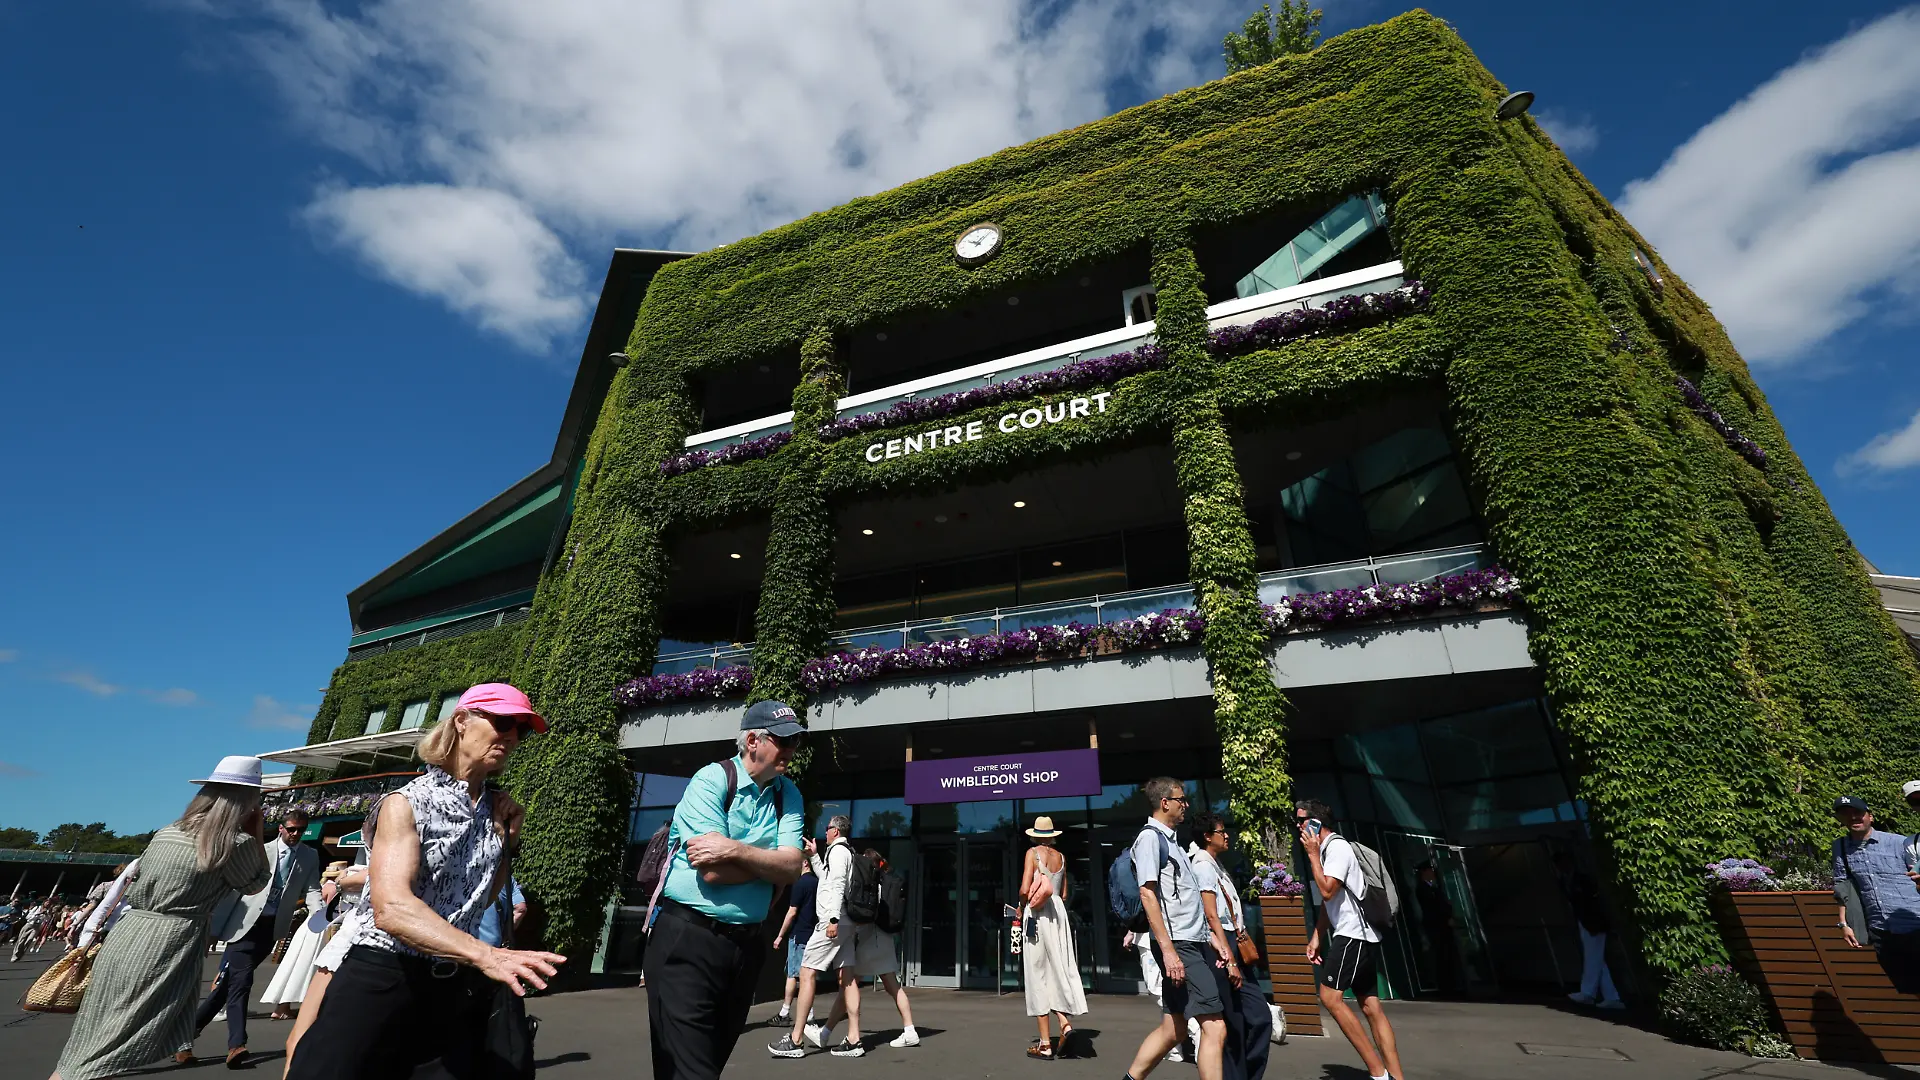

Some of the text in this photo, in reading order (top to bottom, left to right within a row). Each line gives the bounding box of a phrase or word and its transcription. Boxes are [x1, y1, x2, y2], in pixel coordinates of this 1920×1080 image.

[865, 392, 1111, 462] CENTRE COURT
[772, 707, 797, 719] LOND
[973, 763, 1023, 772] CENTRE COURT
[940, 771, 1059, 788] WIMBLEDON SHOP
